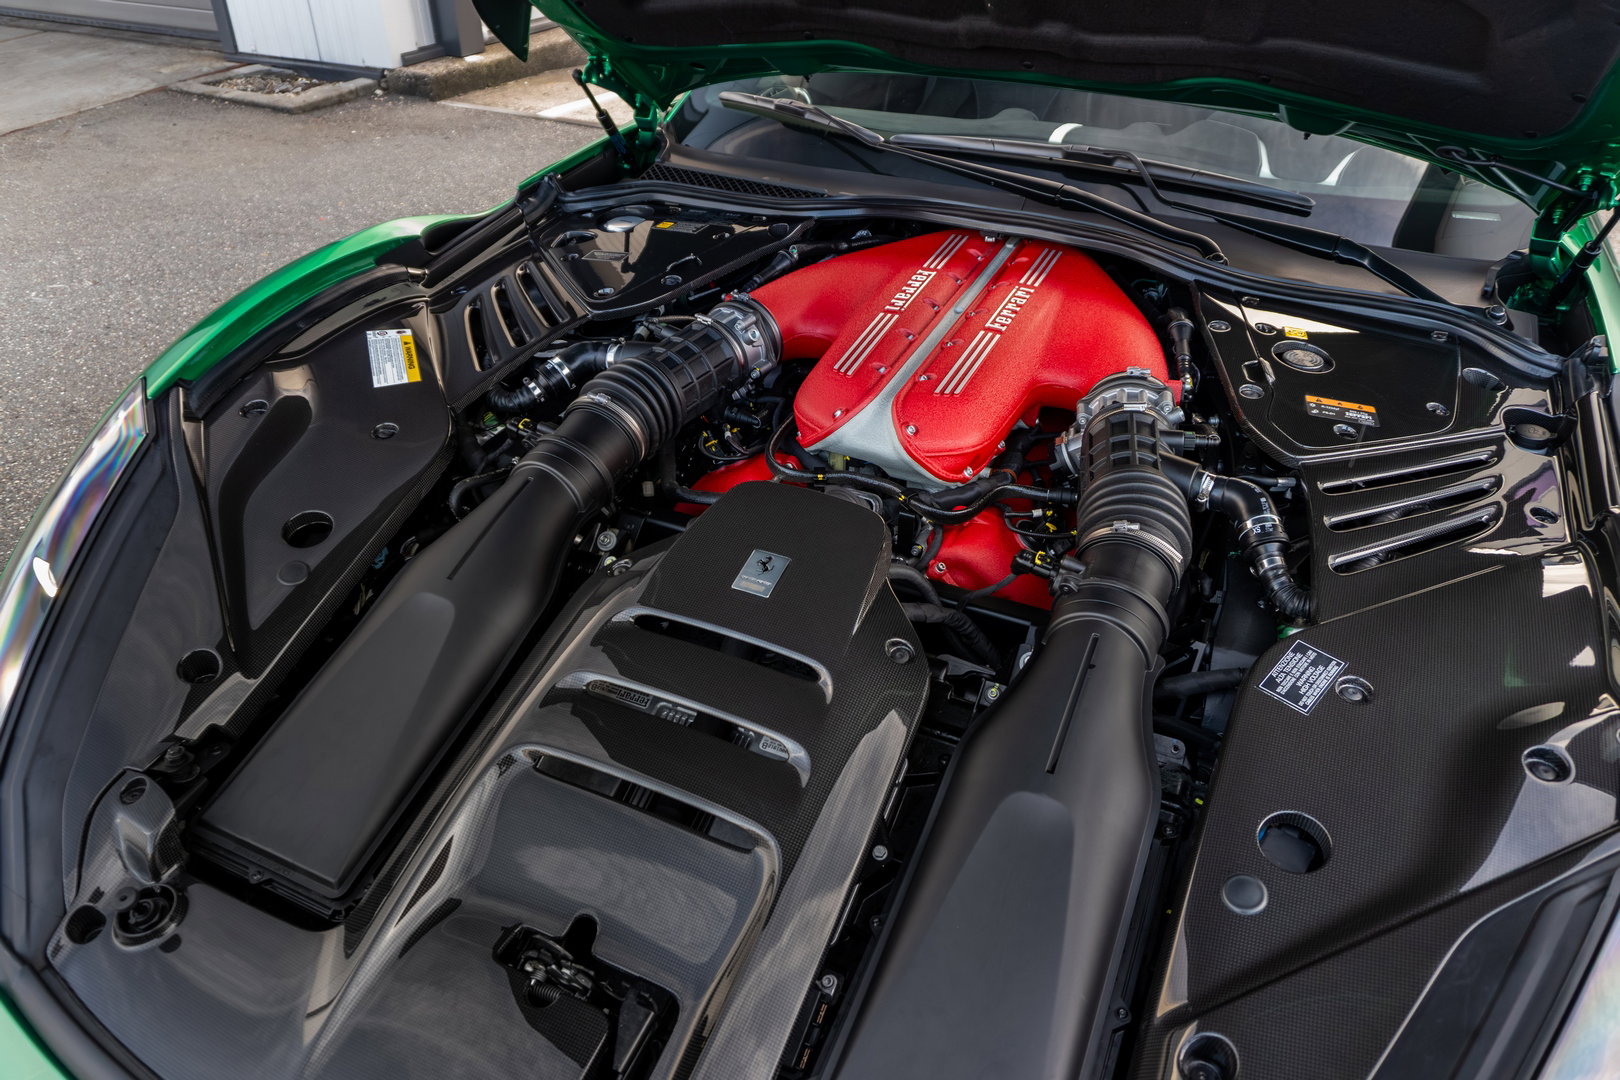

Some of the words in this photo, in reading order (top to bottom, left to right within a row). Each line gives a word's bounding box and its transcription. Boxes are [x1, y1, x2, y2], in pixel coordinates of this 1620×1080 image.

[885, 269, 937, 311] Ferrari
[985, 285, 1035, 332] Ferrari
[405, 346, 416, 370] WARNING
[1271, 651, 1296, 678] ATTENZIONE
[1275, 672, 1287, 684] ALTA
[1283, 652, 1304, 673] TENSIONE
[1295, 665, 1316, 687] WARNING
[1299, 682, 1311, 695] HIGH
[1307, 664, 1326, 684] VOLTAGE
[616, 689, 650, 708] Ferrari
